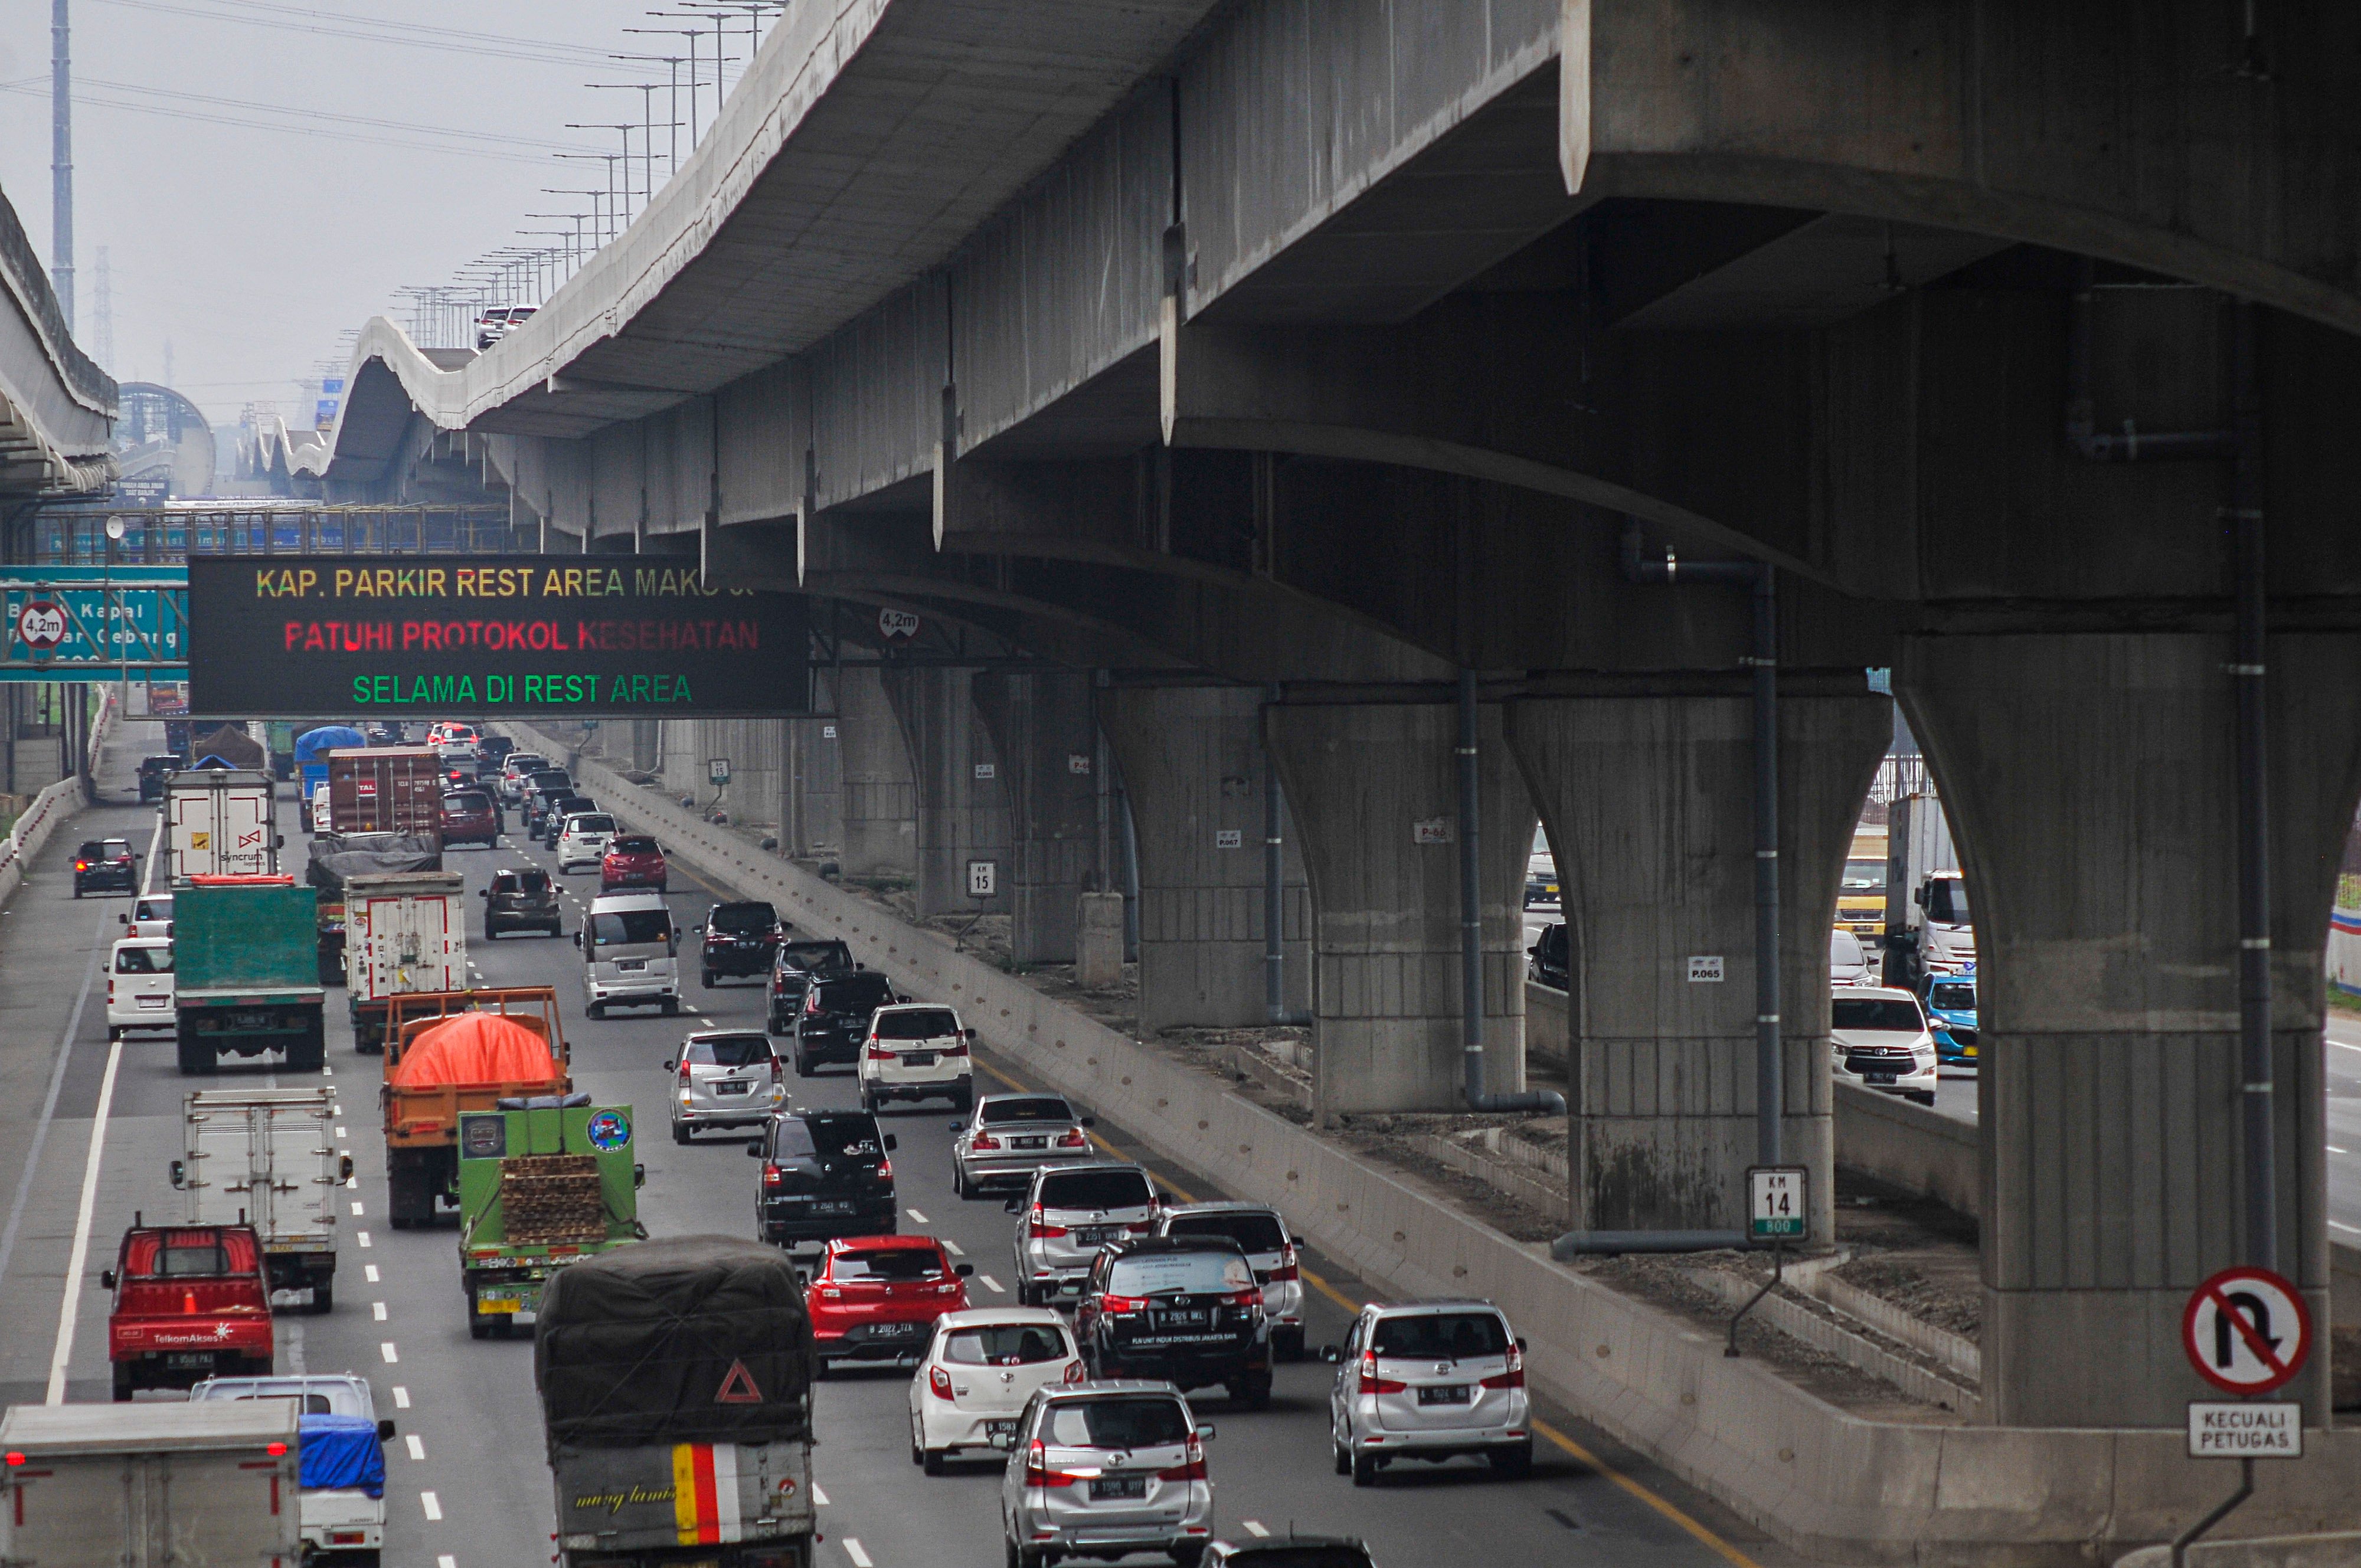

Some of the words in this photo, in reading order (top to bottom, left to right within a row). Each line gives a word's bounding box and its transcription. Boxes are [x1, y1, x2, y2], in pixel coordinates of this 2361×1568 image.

[256, 569, 325, 597] KAP.
[335, 569, 446, 597] PARKIR
[457, 568, 534, 597] REST
[542, 568, 625, 596] AREA
[635, 568, 719, 596] MAK
[26, 618, 60, 634] 4,2m
[883, 614, 916, 628] 4,2m
[285, 621, 393, 651] PATUHI
[403, 621, 568, 650] PROTOKOL
[578, 620, 758, 650] KESEHATAN
[353, 675, 477, 703] SELAMA
[487, 675, 513, 702] DI
[525, 675, 601, 703] REST
[610, 675, 692, 702] AREA
[716, 768, 724, 776] 15
[221, 854, 263, 863] syncrum
[976, 875, 989, 889] 15
[1692, 970, 1720, 978] P.065
[1768, 1176, 1786, 1188] KM
[1766, 1193, 1790, 1216] 14
[154, 1334, 218, 1344] TelkomAkses
[2205, 1411, 2285, 1428] KECUALI
[2201, 1431, 2290, 1449] PETUGAS
